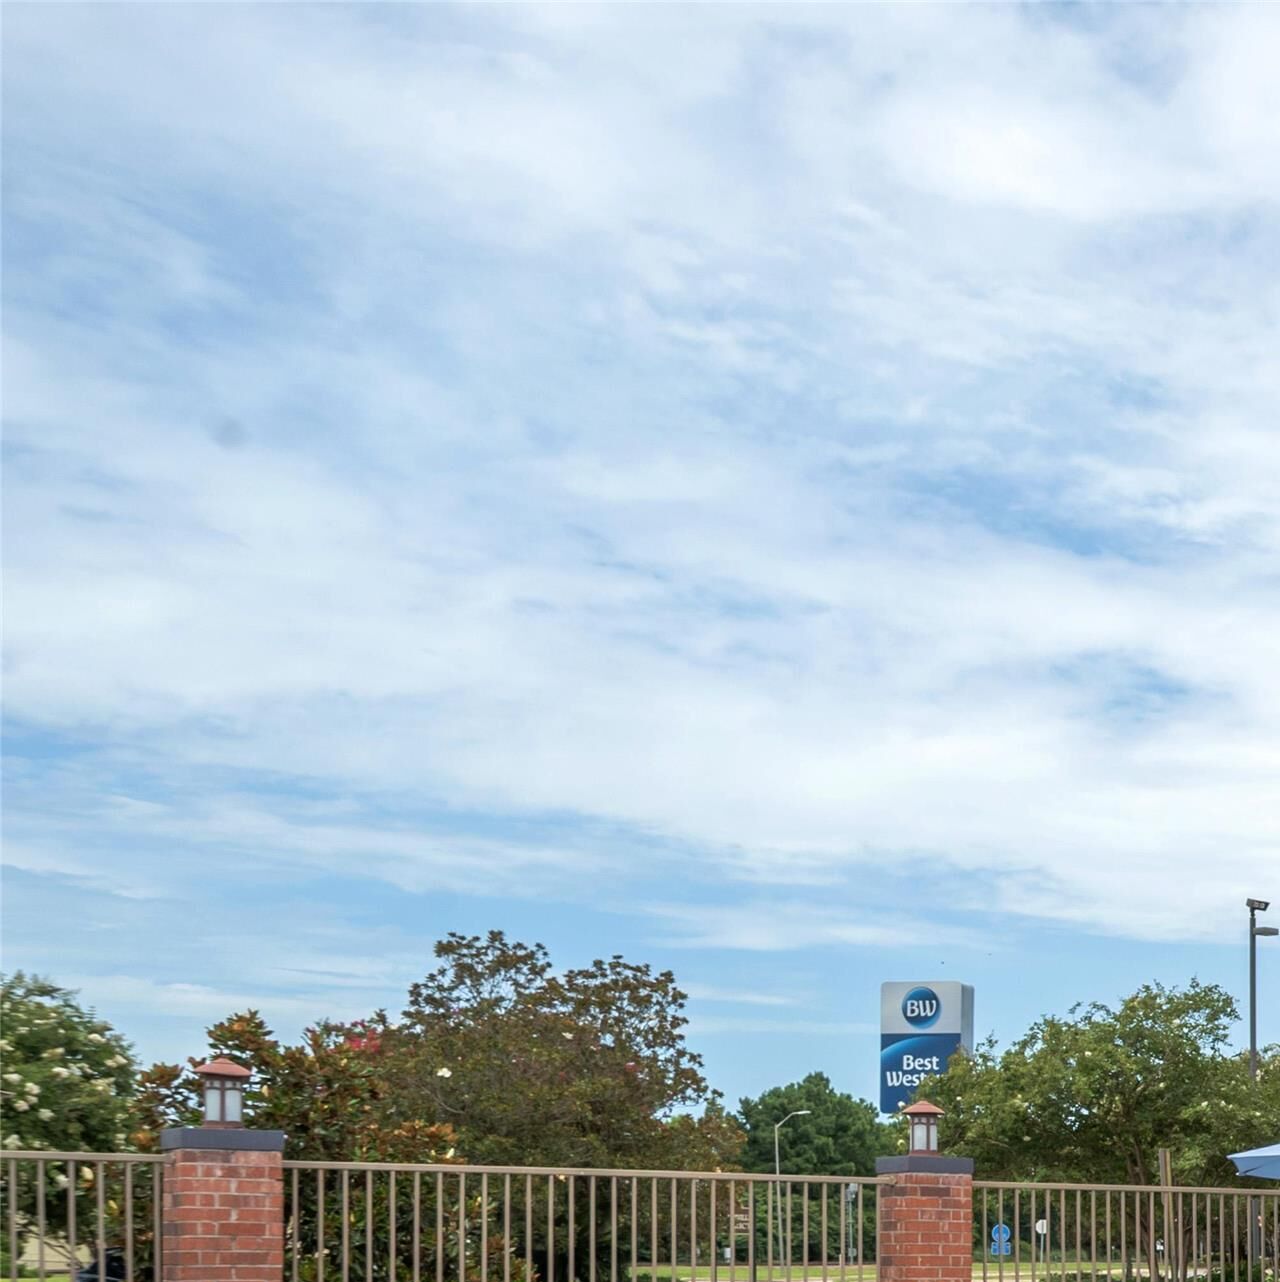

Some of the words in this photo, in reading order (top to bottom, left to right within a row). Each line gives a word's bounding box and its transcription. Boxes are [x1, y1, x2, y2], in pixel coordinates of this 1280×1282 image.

[906, 1000, 937, 1017] BW
[902, 1055, 940, 1071] Best
[886, 1071, 949, 1087] West
